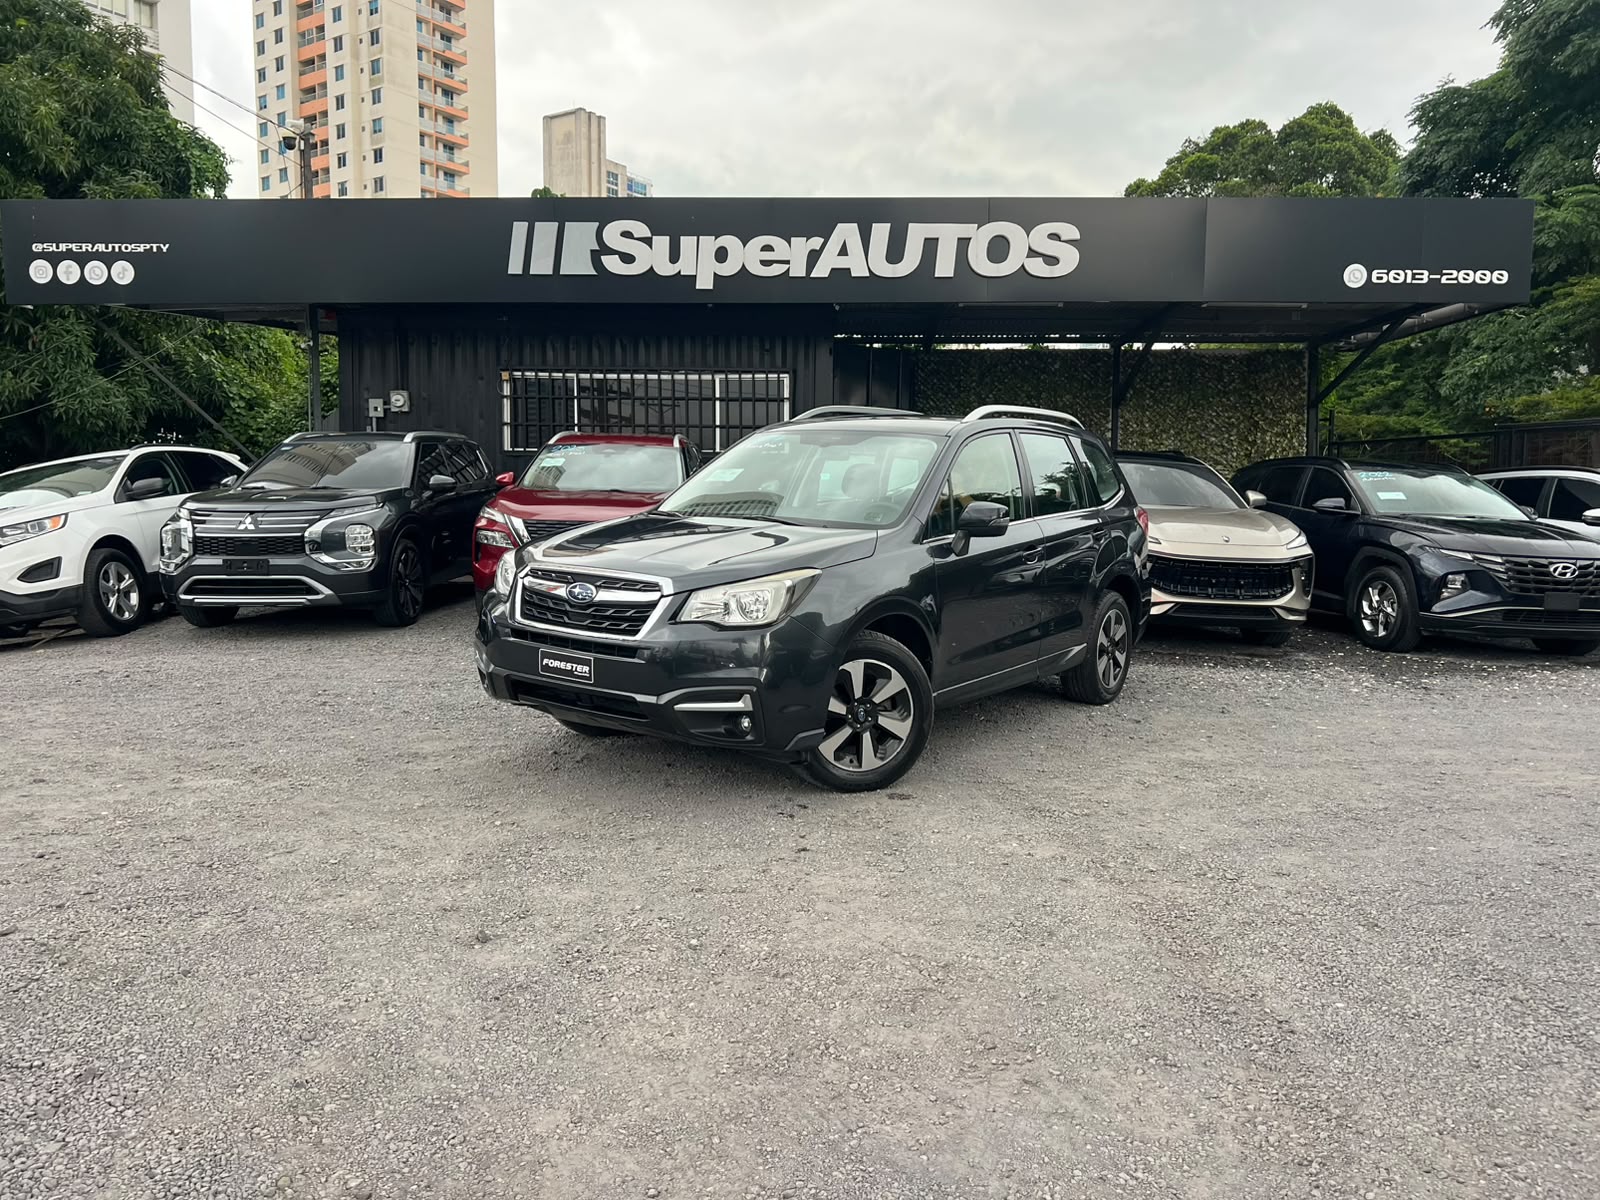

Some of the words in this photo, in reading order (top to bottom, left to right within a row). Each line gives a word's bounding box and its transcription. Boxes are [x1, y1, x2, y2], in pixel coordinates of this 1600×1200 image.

[32, 242, 169, 252] @SUPERAUTOSPTY
[600, 219, 1081, 290] SuperAUTOS
[1371, 269, 1509, 284] 6013-2000
[542, 658, 590, 673] FORESTER
